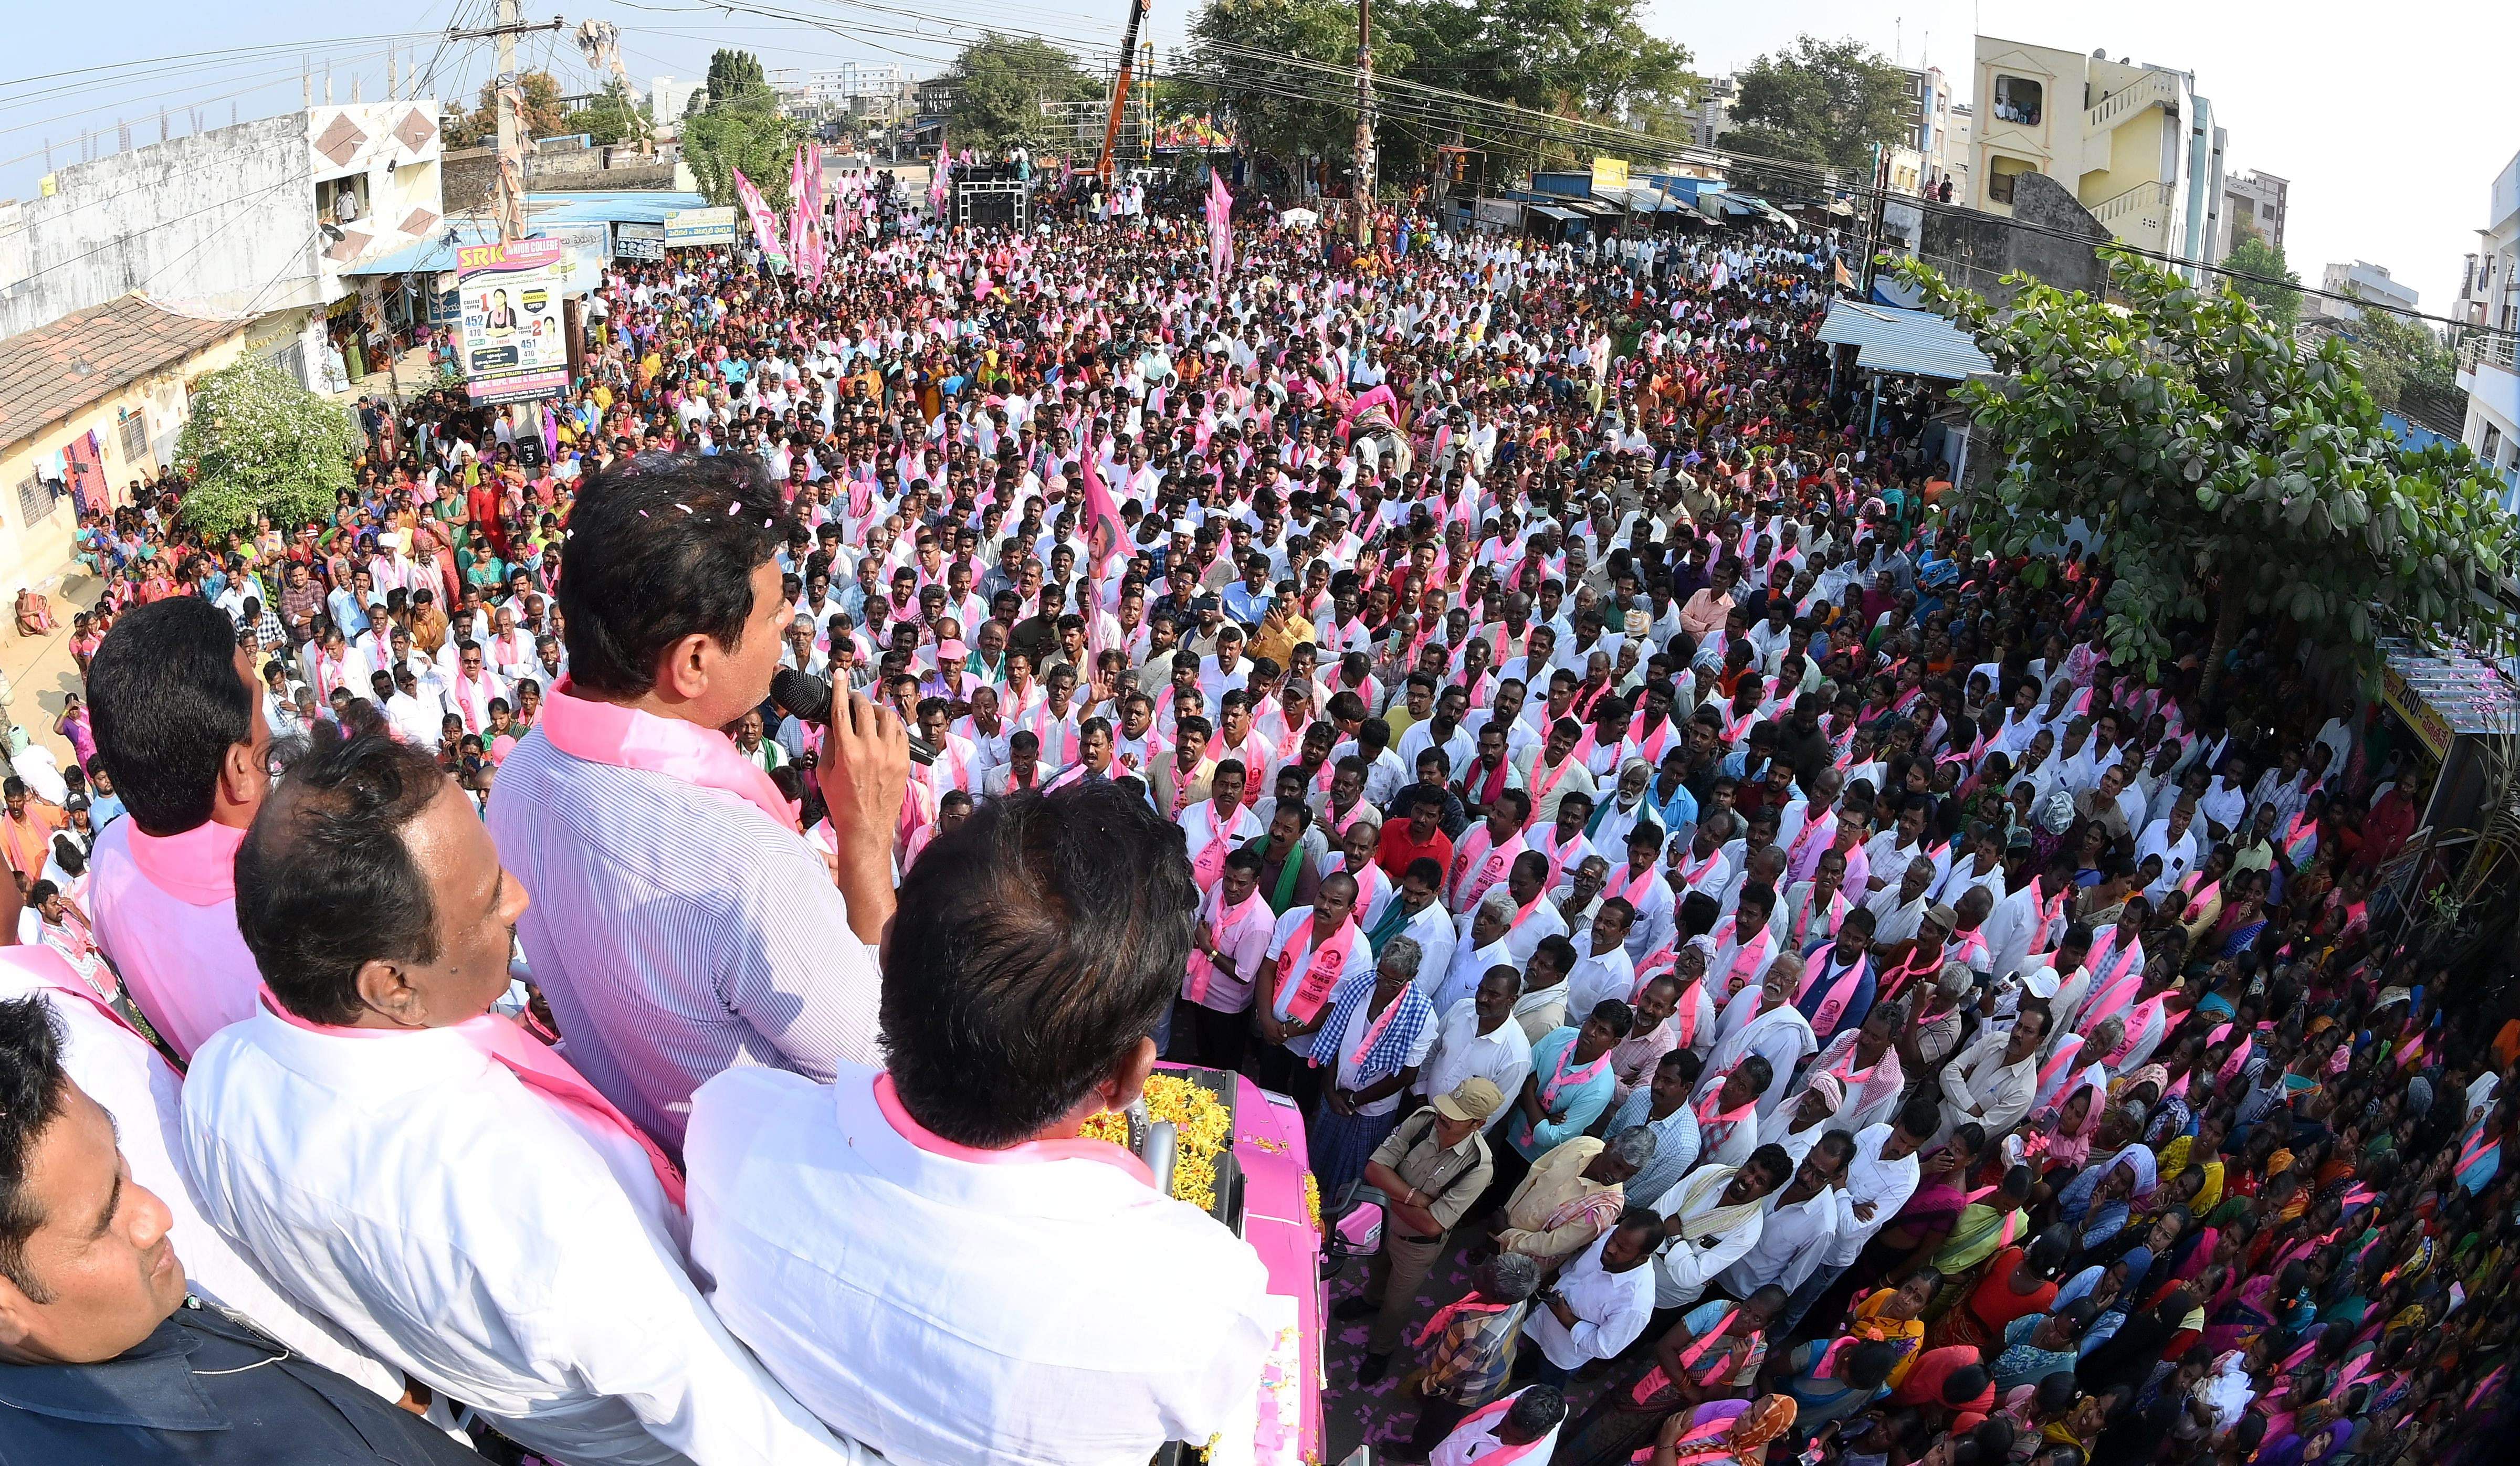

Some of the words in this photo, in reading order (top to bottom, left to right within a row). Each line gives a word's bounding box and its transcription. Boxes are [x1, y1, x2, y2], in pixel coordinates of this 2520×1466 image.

[459, 245, 507, 268] SRK
[530, 239, 559, 252] COLLEGE
[480, 293, 489, 312] 1
[465, 314, 484, 328] 452
[469, 329, 481, 337] 470
[532, 320, 542, 336] 2
[521, 339, 537, 349] 451
[526, 452, 534, 462] 3
[1311, 973, 1330, 984] BRS
